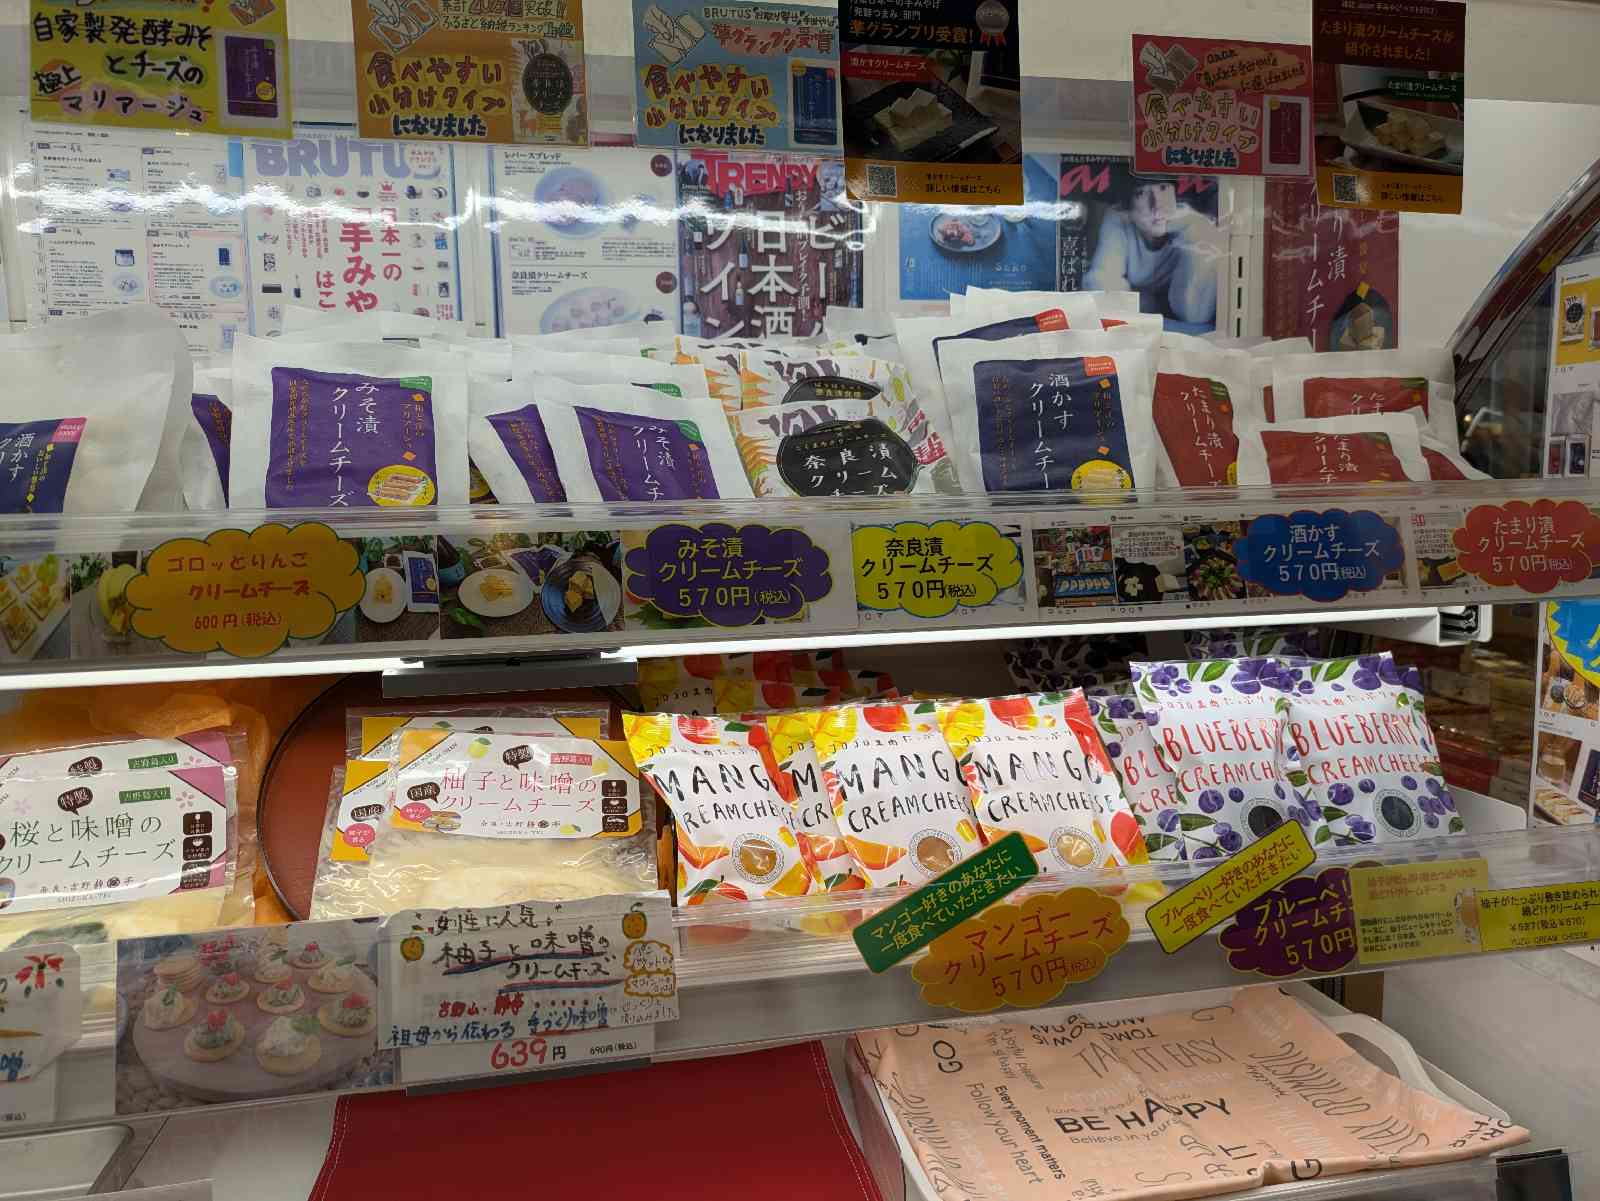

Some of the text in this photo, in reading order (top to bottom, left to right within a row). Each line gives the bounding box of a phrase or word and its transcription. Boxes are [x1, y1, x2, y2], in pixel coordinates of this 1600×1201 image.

[33, 10, 213, 51] 自家製発酵みそ
[704, 8, 751, 20] BRUTUS
[106, 51, 204, 85] とチーズの
[367, 52, 502, 88] 食べやすい
[645, 64, 769, 99] 食べやすい
[63, 87, 211, 123] マリアージュ
[369, 86, 506, 115] 小分けタイプ
[646, 95, 776, 126] 小分けタイプ
[1144, 89, 1259, 125] 食べやすい
[393, 114, 487, 137] になりました
[679, 122, 764, 145] になりました
[252, 138, 442, 180] BRUTU
[1165, 146, 1237, 167] になりました
[355, 382, 381, 434] みそ漬
[1049, 373, 1074, 431] 酒かす
[1191, 385, 1224, 448] たまり漬
[10, 432, 36, 482] 酒かす
[329, 386, 353, 508] クリームチーズ
[649, 425, 676, 471] みそ漬
[804, 442, 894, 470] 奈良漬
[1334, 434, 1360, 473] たまり漬
[811, 466, 897, 489] クリーム
[1289, 523, 1339, 544] 酒かす
[1478, 532, 1584, 553] クリームチーズ
[1493, 516, 1556, 535] たまり漬
[167, 552, 308, 572] ゴロッとりんご
[677, 537, 744, 559] みそ漬
[885, 537, 944, 557] 奈良漬
[1263, 540, 1379, 563] クリームチーズ
[658, 557, 803, 582] クリームチーズ
[861, 553, 994, 577] クリームチーズ
[189, 580, 311, 600] クリームチーズ
[441, 767, 597, 794] 柚子と味噌の
[975, 749, 1102, 794] MANGO
[440, 796, 594, 812] クリームチーズ
[9, 813, 163, 848] 桜と味噌の
[0, 838, 176, 875] クリームチーズ
[871, 847, 1013, 940] マンゴー好きのあなたに
[1160, 834, 1295, 926] ブルーベリー好きのあなたに
[1173, 851, 1300, 934] 一度食べていただきたい
[434, 905, 538, 936] 女性に人気
[881, 865, 1022, 953] 一度食べていただきたい
[433, 925, 610, 967] 柚子と味噌の
[966, 906, 1071, 951] マンゴー
[945, 912, 1114, 985] クリームチーズ
[1286, 929, 1355, 965] 570円
[390, 1020, 516, 1047] 祖母から伝わる
[491, 1038, 567, 1070] 639円
[1161, 1036, 1236, 1069] EASY
[1249, 1041, 1371, 1116] OPTIMISTIC
[994, 1083, 1015, 1110] Every
[1010, 1108, 1042, 1144] moment
[1036, 1143, 1067, 1181] matters
[1053, 1115, 1111, 1134] BE
[1070, 1135, 1123, 1145] believe
[1343, 1115, 1431, 1154] STAY
[1010, 1149, 1045, 1185] heart
